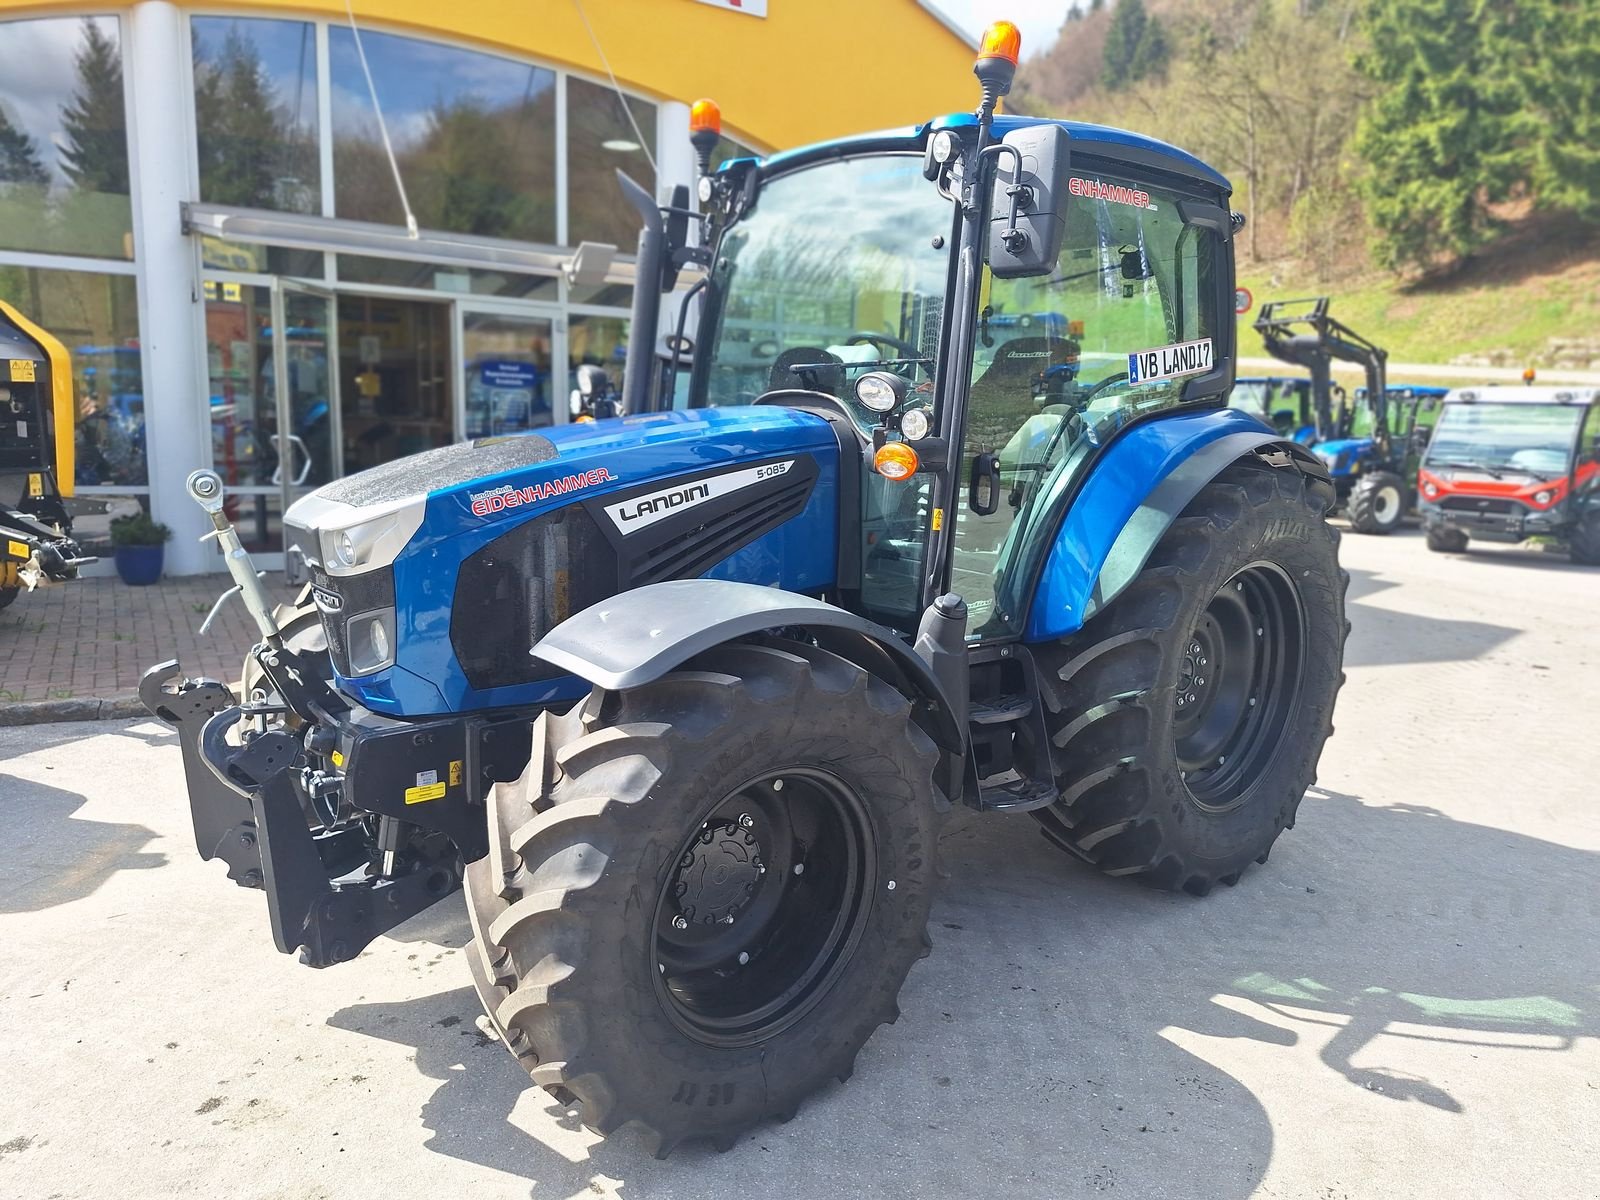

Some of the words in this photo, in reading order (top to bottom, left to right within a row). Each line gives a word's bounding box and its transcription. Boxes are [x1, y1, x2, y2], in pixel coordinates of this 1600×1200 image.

[1068, 178, 1149, 208] ENHAMMER
[1140, 353, 1158, 379] VB
[757, 464, 786, 478] 5-085
[472, 468, 611, 516] EIDENHAMMER
[619, 484, 710, 521] LANDINI
